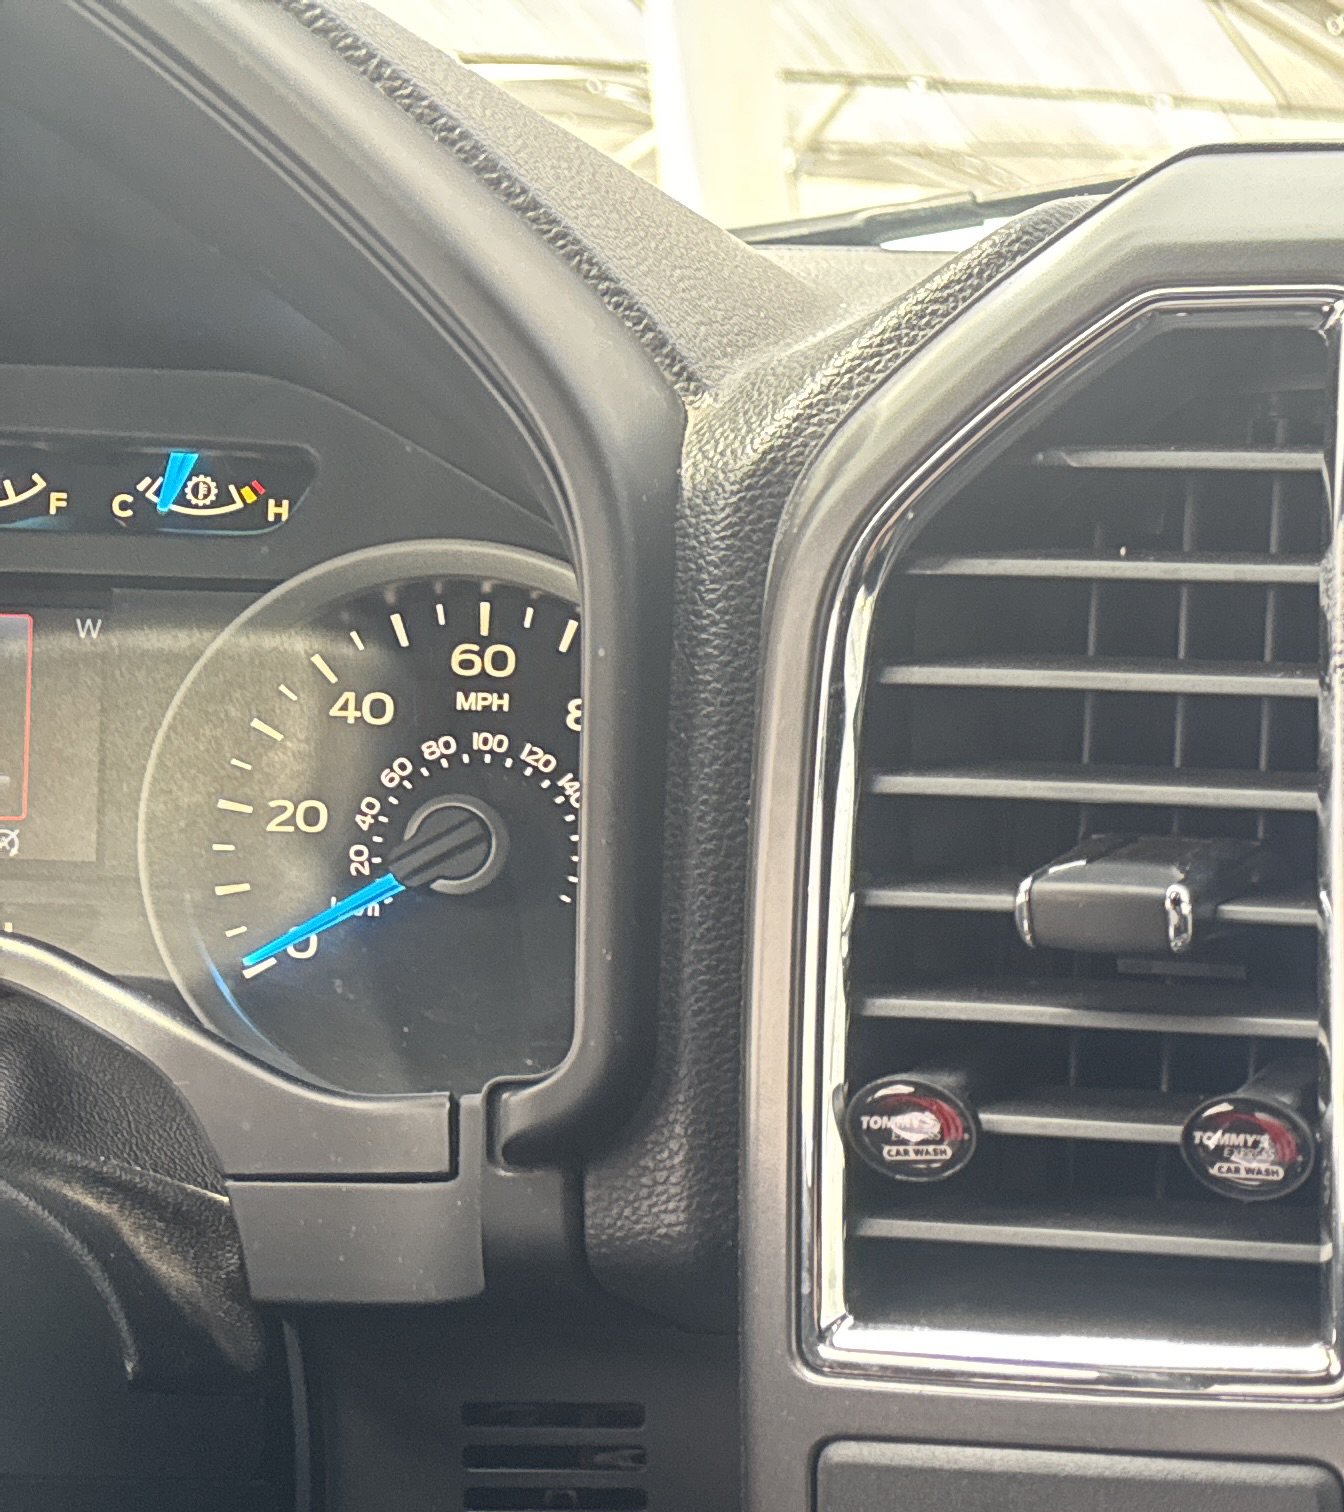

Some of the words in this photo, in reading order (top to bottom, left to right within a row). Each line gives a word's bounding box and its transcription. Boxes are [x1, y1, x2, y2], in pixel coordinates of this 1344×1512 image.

[49, 491, 68, 515] F
[112, 493, 134, 518] C
[267, 498, 290, 522] H
[76, 618, 102, 639] W
[451, 643, 516, 678] 60
[329, 691, 395, 726] 40
[455, 691, 510, 712] MPH
[421, 735, 457, 761] 80
[472, 731, 509, 754] 100
[519, 742, 557, 774] 120
[380, 757, 413, 789] 60
[266, 799, 328, 834] 20
[354, 796, 381, 832] 40
[349, 844, 371, 876] 20
[886, 1147, 910, 1158] CAR
[912, 1147, 948, 1159] WASH
[1217, 1165, 1241, 1176] CAR
[1244, 1166, 1280, 1178] WASH
